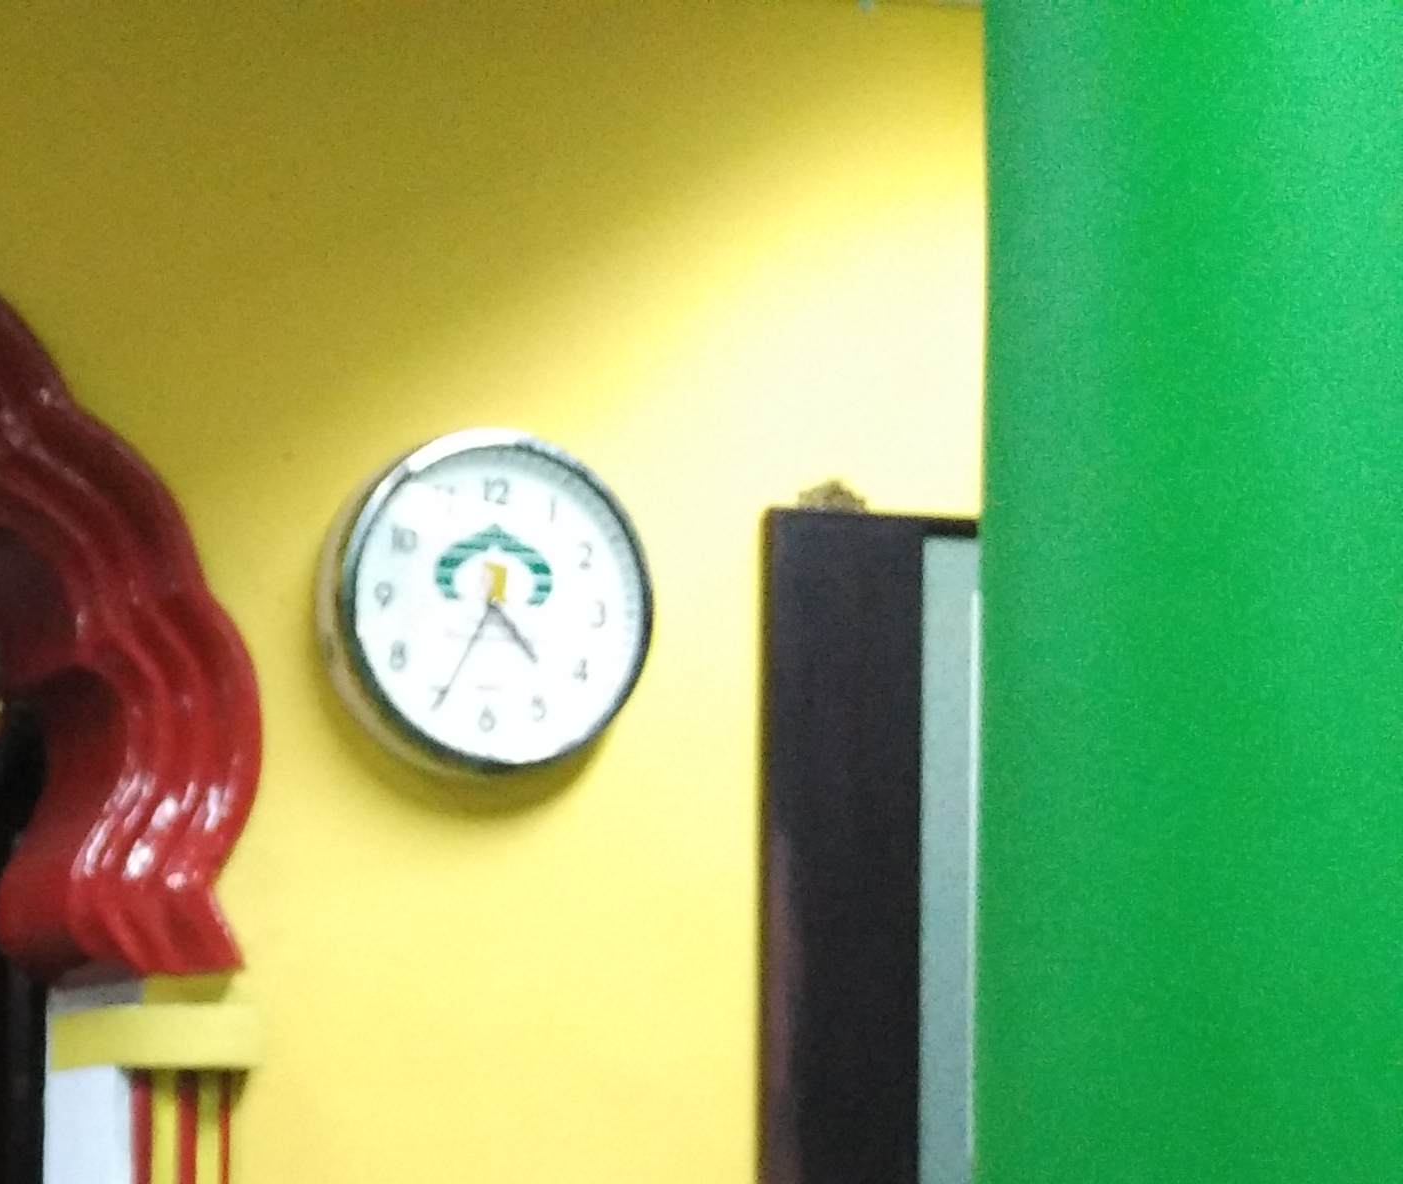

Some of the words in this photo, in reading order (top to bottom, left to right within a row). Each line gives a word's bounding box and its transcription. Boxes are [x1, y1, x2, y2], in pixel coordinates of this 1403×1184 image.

[482, 476, 510, 507] 12
[548, 494, 558, 524] 1
[577, 540, 593, 570] 2
[373, 580, 395, 611] 9
[589, 600, 607, 630] 3
[388, 638, 408, 673] 8
[572, 656, 590, 683] 4
[477, 704, 498, 734] 6
[531, 694, 549, 723] 5
